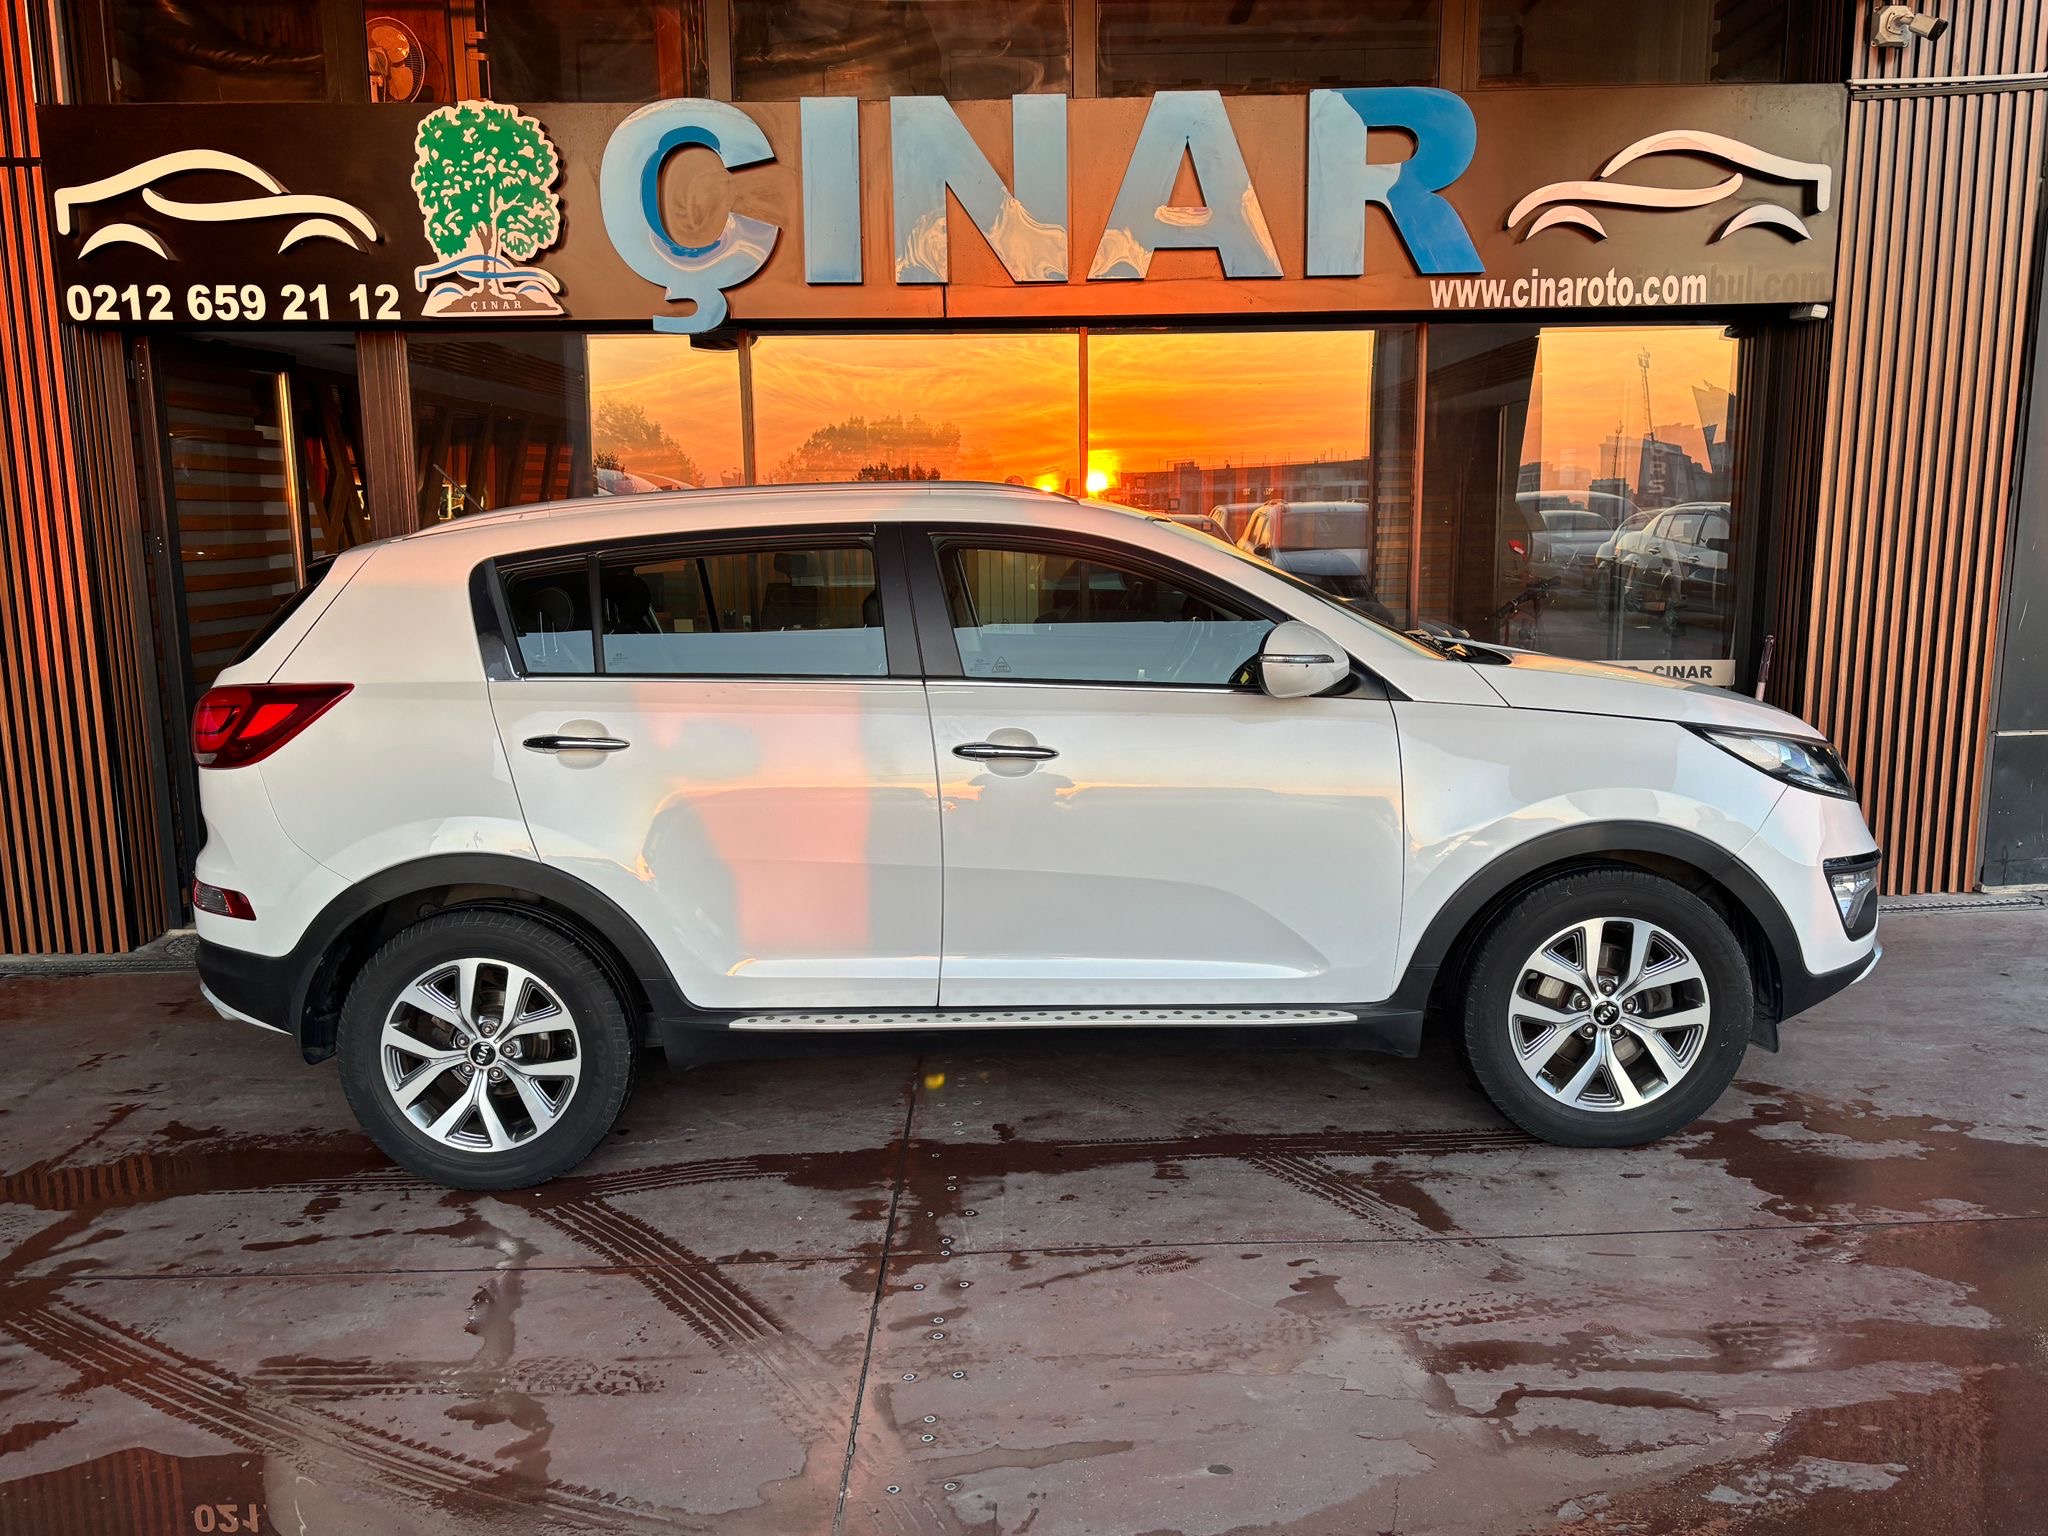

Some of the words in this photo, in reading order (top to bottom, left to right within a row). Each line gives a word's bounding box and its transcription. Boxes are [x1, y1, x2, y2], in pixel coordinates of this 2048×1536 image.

[600, 87, 1484, 333] ÇINAR
[66, 283, 174, 321] 0212
[187, 283, 266, 321] 659
[281, 283, 330, 321] 21
[349, 283, 401, 321] 12
[1430, 268, 1707, 308] www.cinaroto.com
[470, 300, 522, 313] ÇINAR
[1597, 1005, 1617, 1023] KIA
[475, 1045, 490, 1064] KIA
